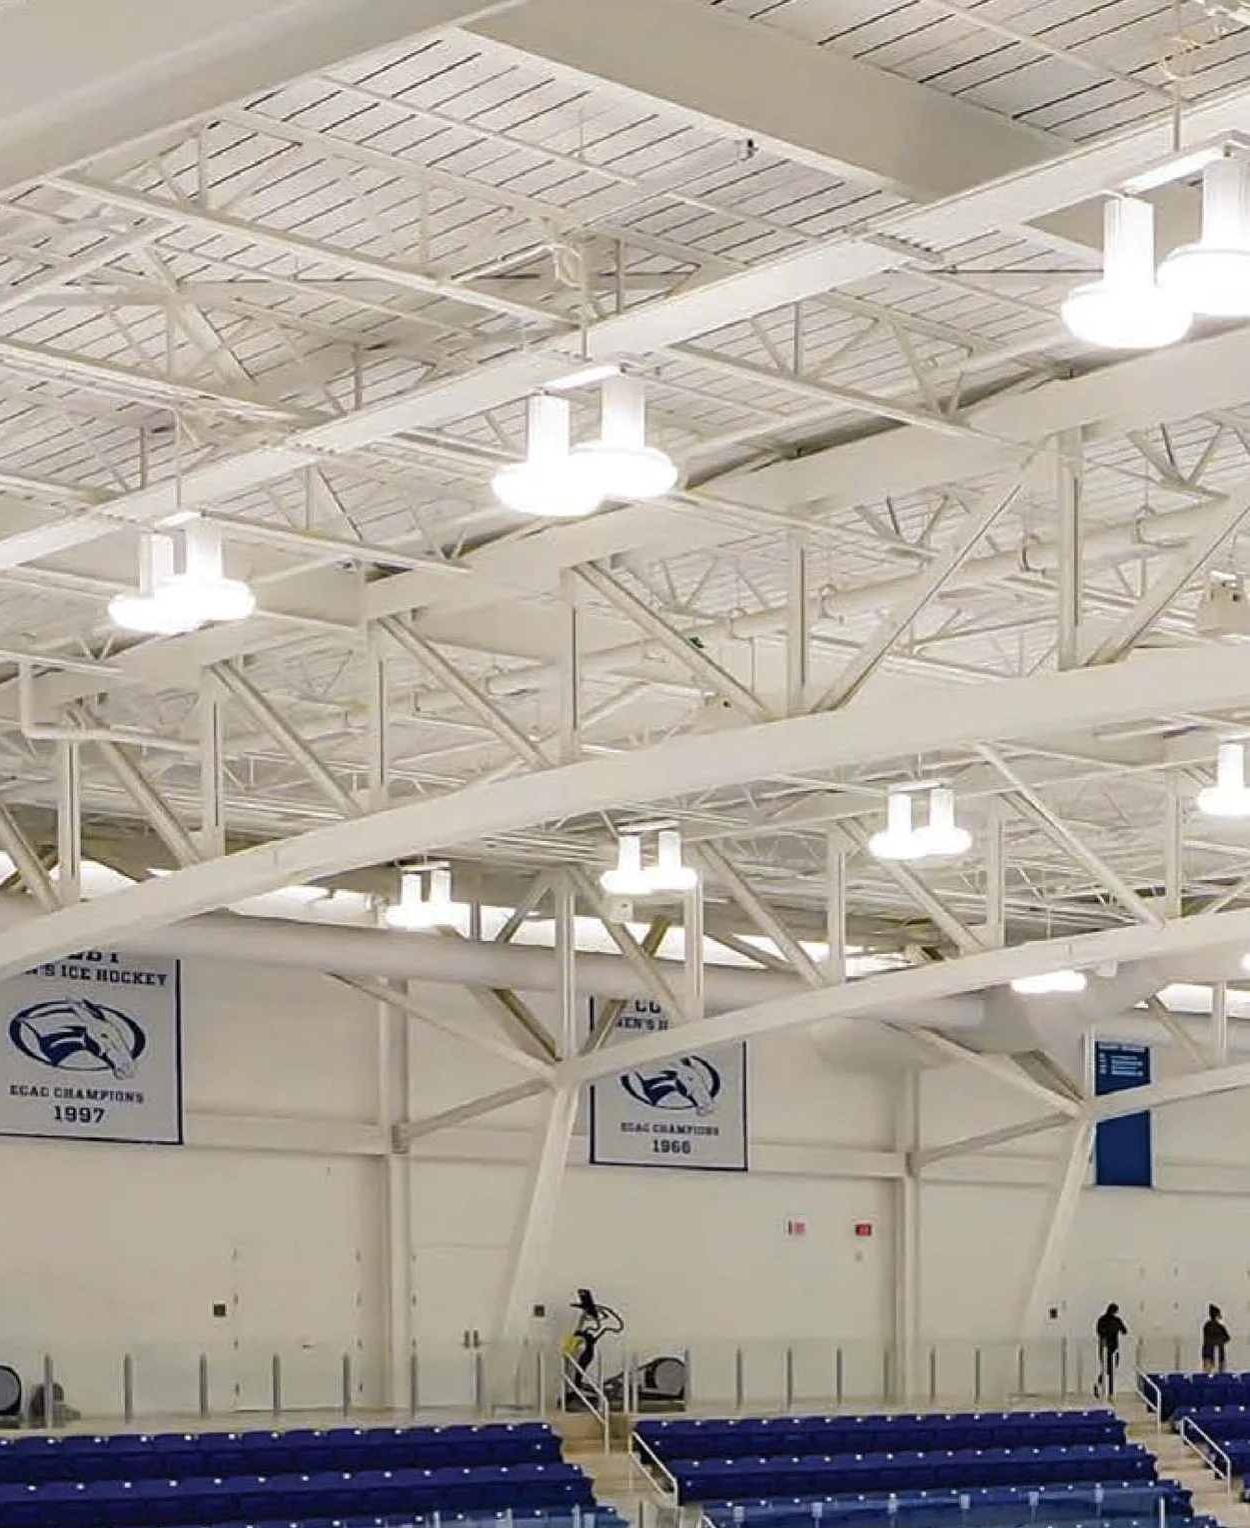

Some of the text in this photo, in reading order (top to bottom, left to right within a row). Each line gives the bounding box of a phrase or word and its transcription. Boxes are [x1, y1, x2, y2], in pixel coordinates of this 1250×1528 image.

[61, 964, 91, 981] ICE
[96, 967, 168, 986] HOCKEY
[10, 1085, 144, 1103] ECAC CHAMPIONS
[54, 1105, 105, 1123] 1997
